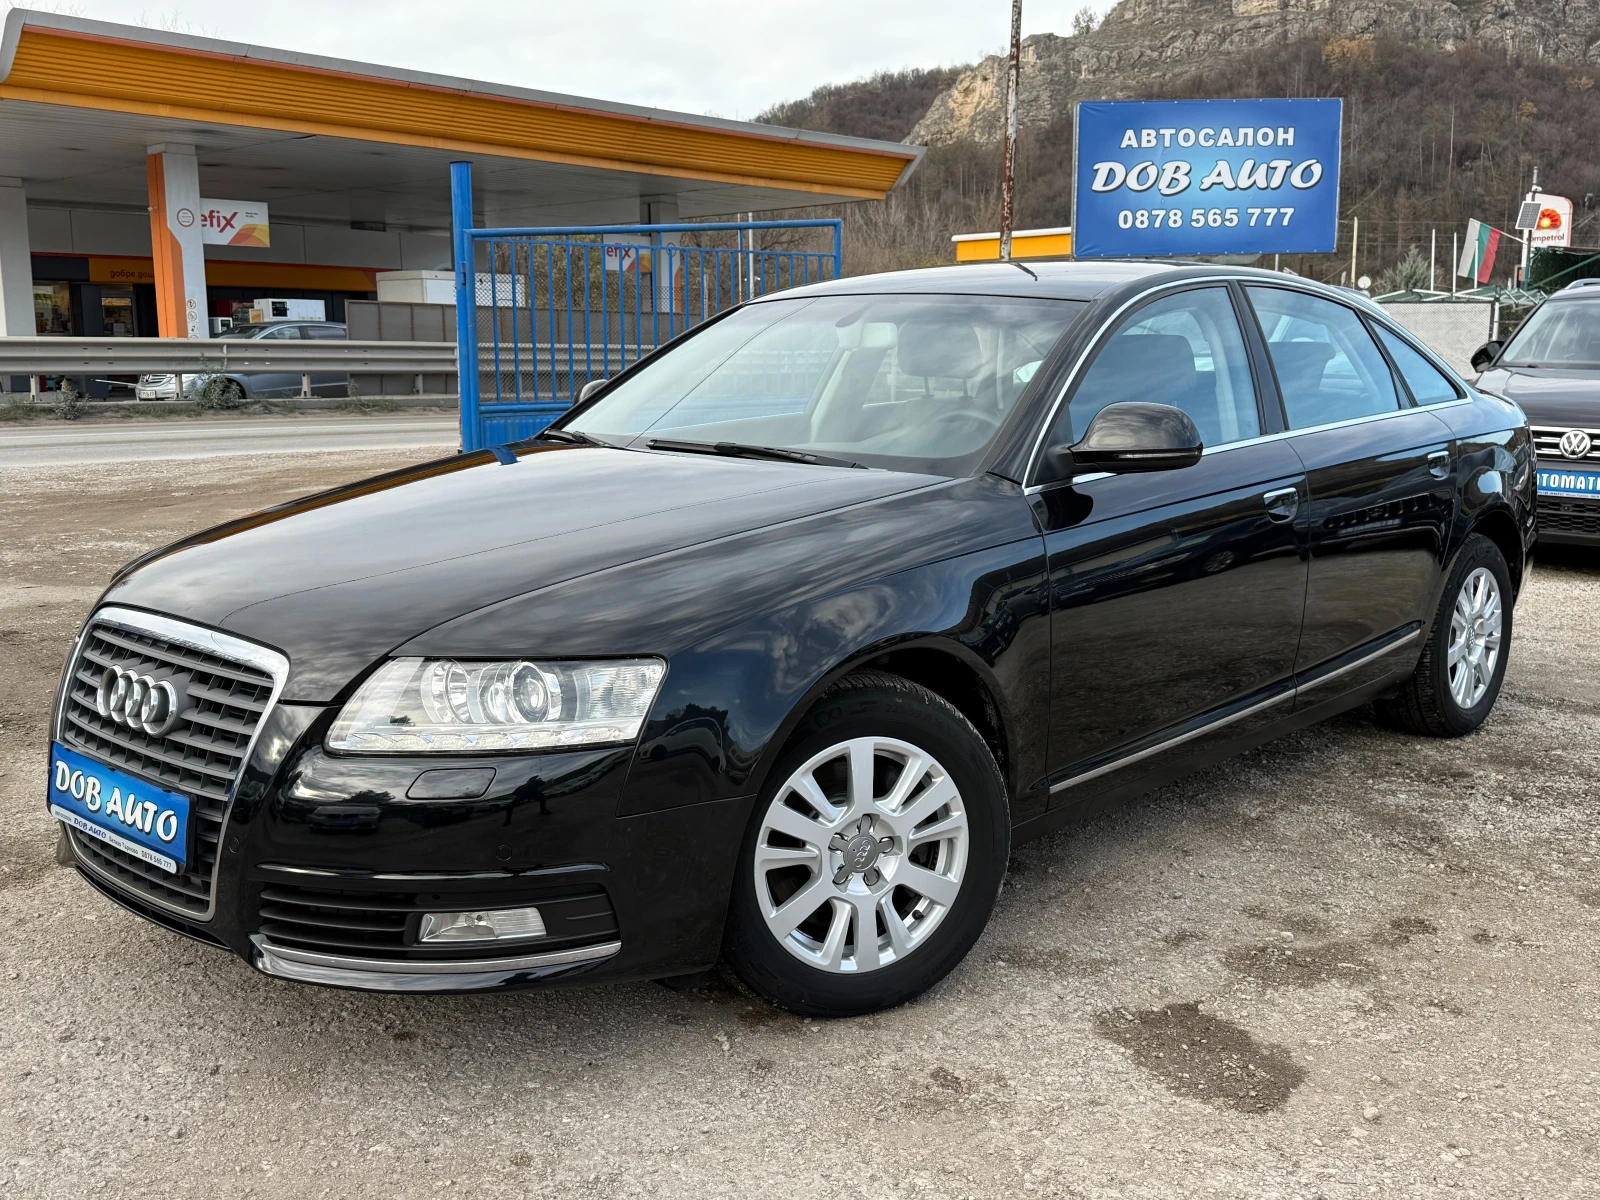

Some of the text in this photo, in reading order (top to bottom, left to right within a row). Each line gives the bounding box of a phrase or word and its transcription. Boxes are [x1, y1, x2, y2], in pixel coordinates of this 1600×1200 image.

[1120, 127, 1295, 149] АВТОСАЛОН
[1091, 159, 1323, 196] DOB AUTO
[1118, 207, 1295, 229] 0878 565 777
[1531, 233, 1565, 244] ompetrol
[55, 760, 178, 842] DOB AUTO
[74, 818, 88, 831] DOB
[89, 825, 106, 839] AUTO
